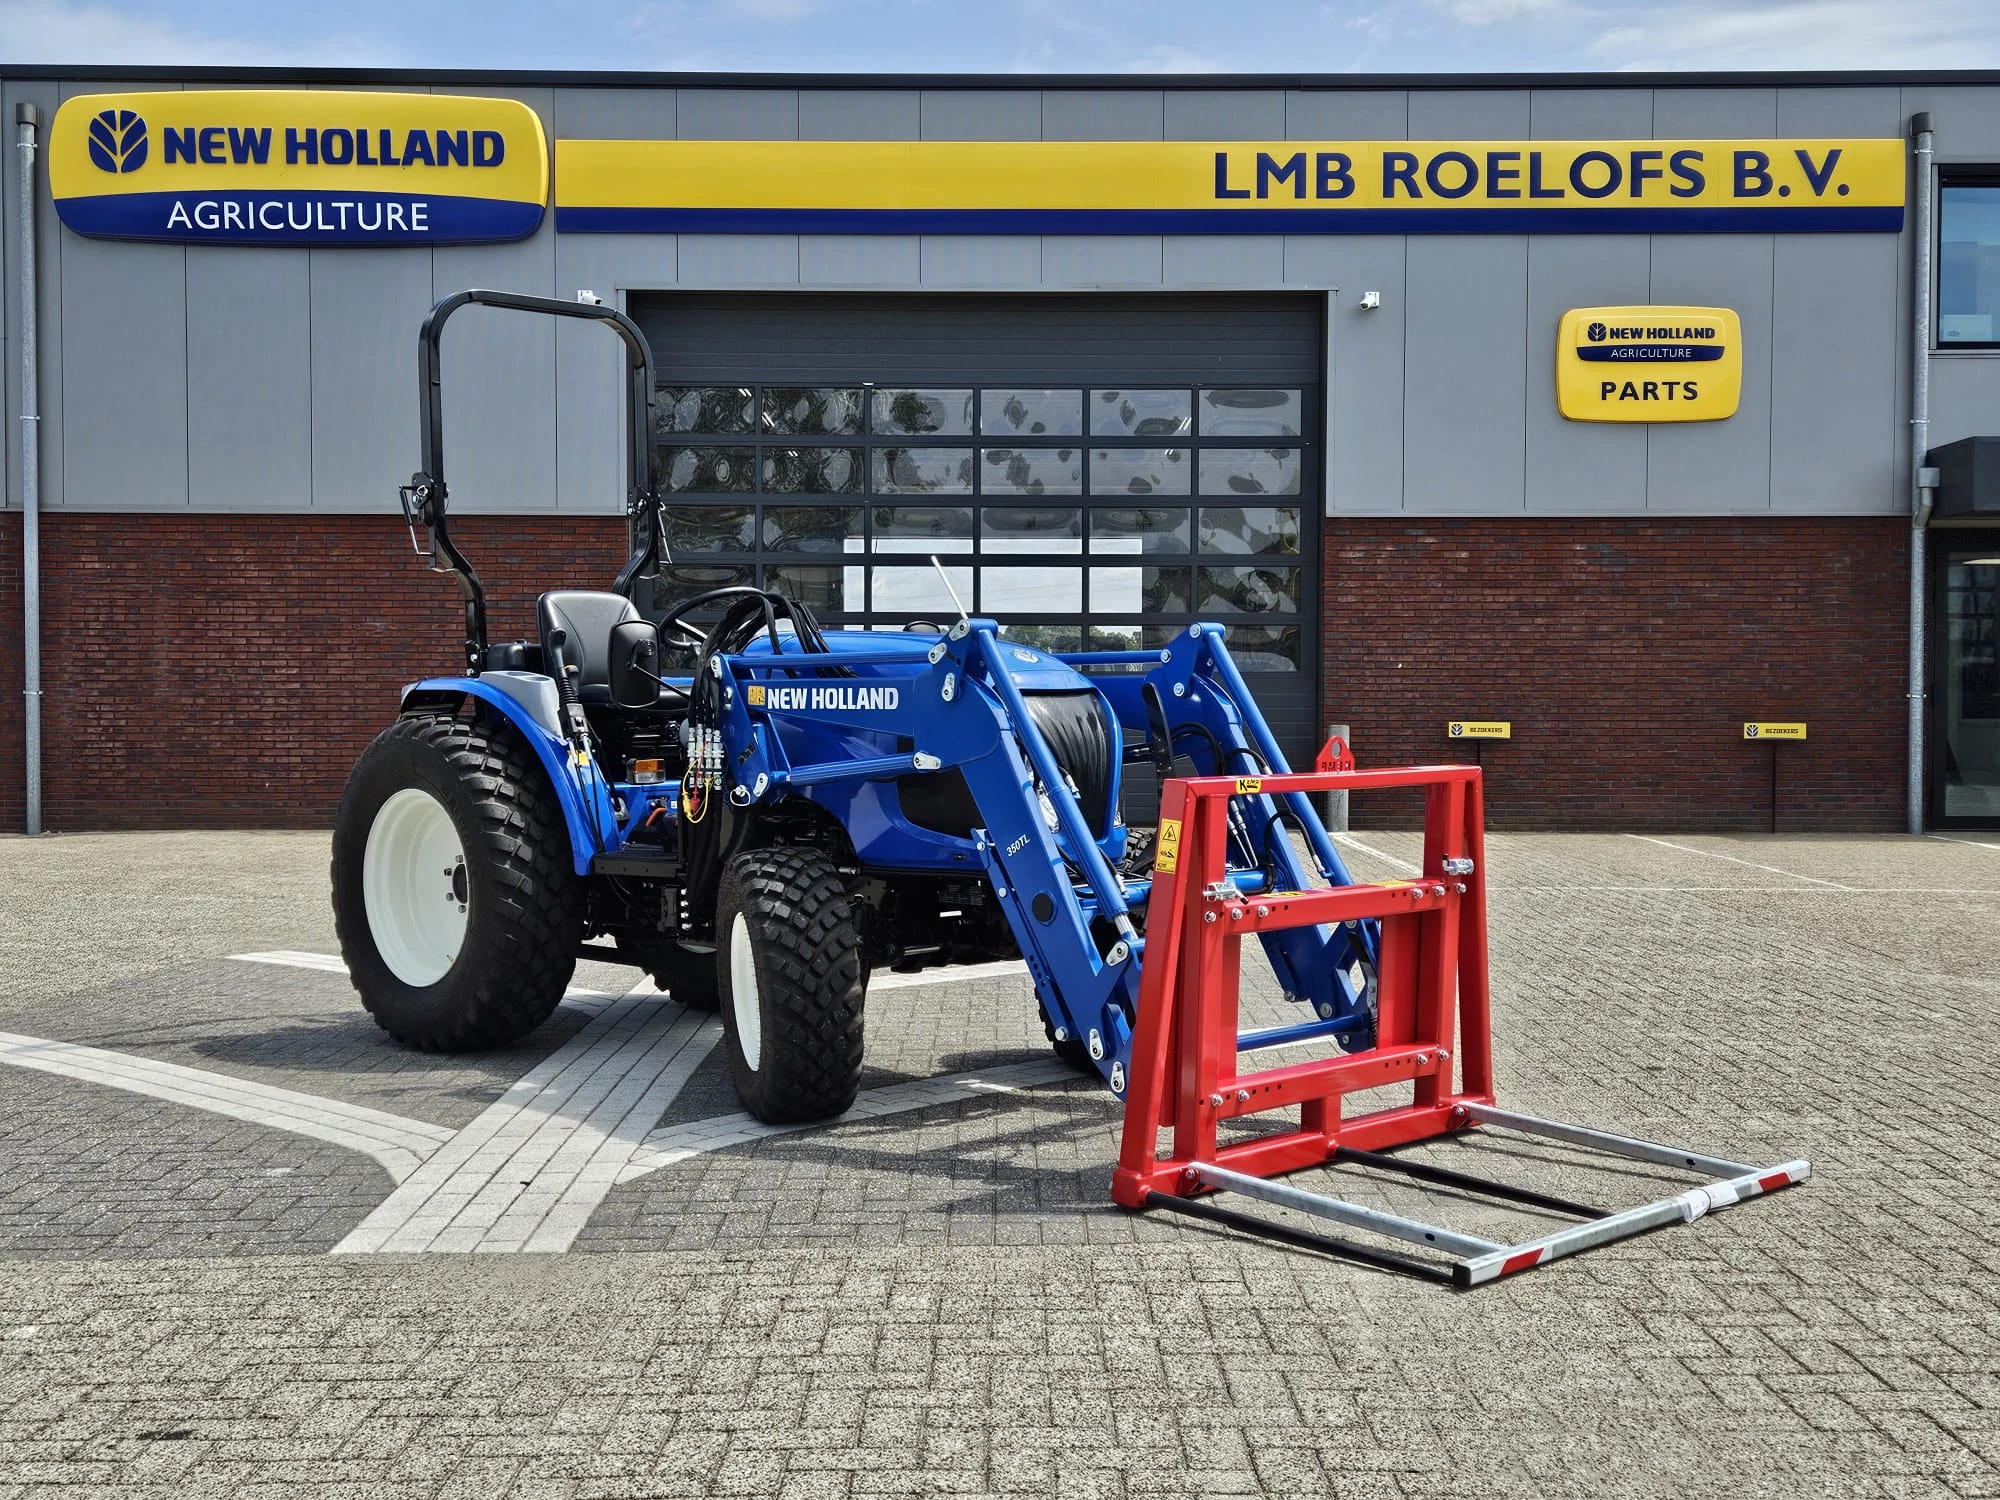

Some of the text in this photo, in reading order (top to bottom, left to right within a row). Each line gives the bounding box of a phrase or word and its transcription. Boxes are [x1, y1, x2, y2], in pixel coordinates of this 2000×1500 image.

[163, 127, 505, 168] NEW HOLLAND
[1214, 149, 1850, 200] LMB ROELOFS B.V.
[166, 200, 429, 231] AGRICULTURE
[1610, 327, 1716, 340] NEW HOLLAND
[1610, 348, 1692, 358] AGRICULTURE
[1601, 381, 1698, 401] PARTS
[767, 687, 899, 710] NEW HOLLAND
[1006, 833, 1031, 857] 350TL
